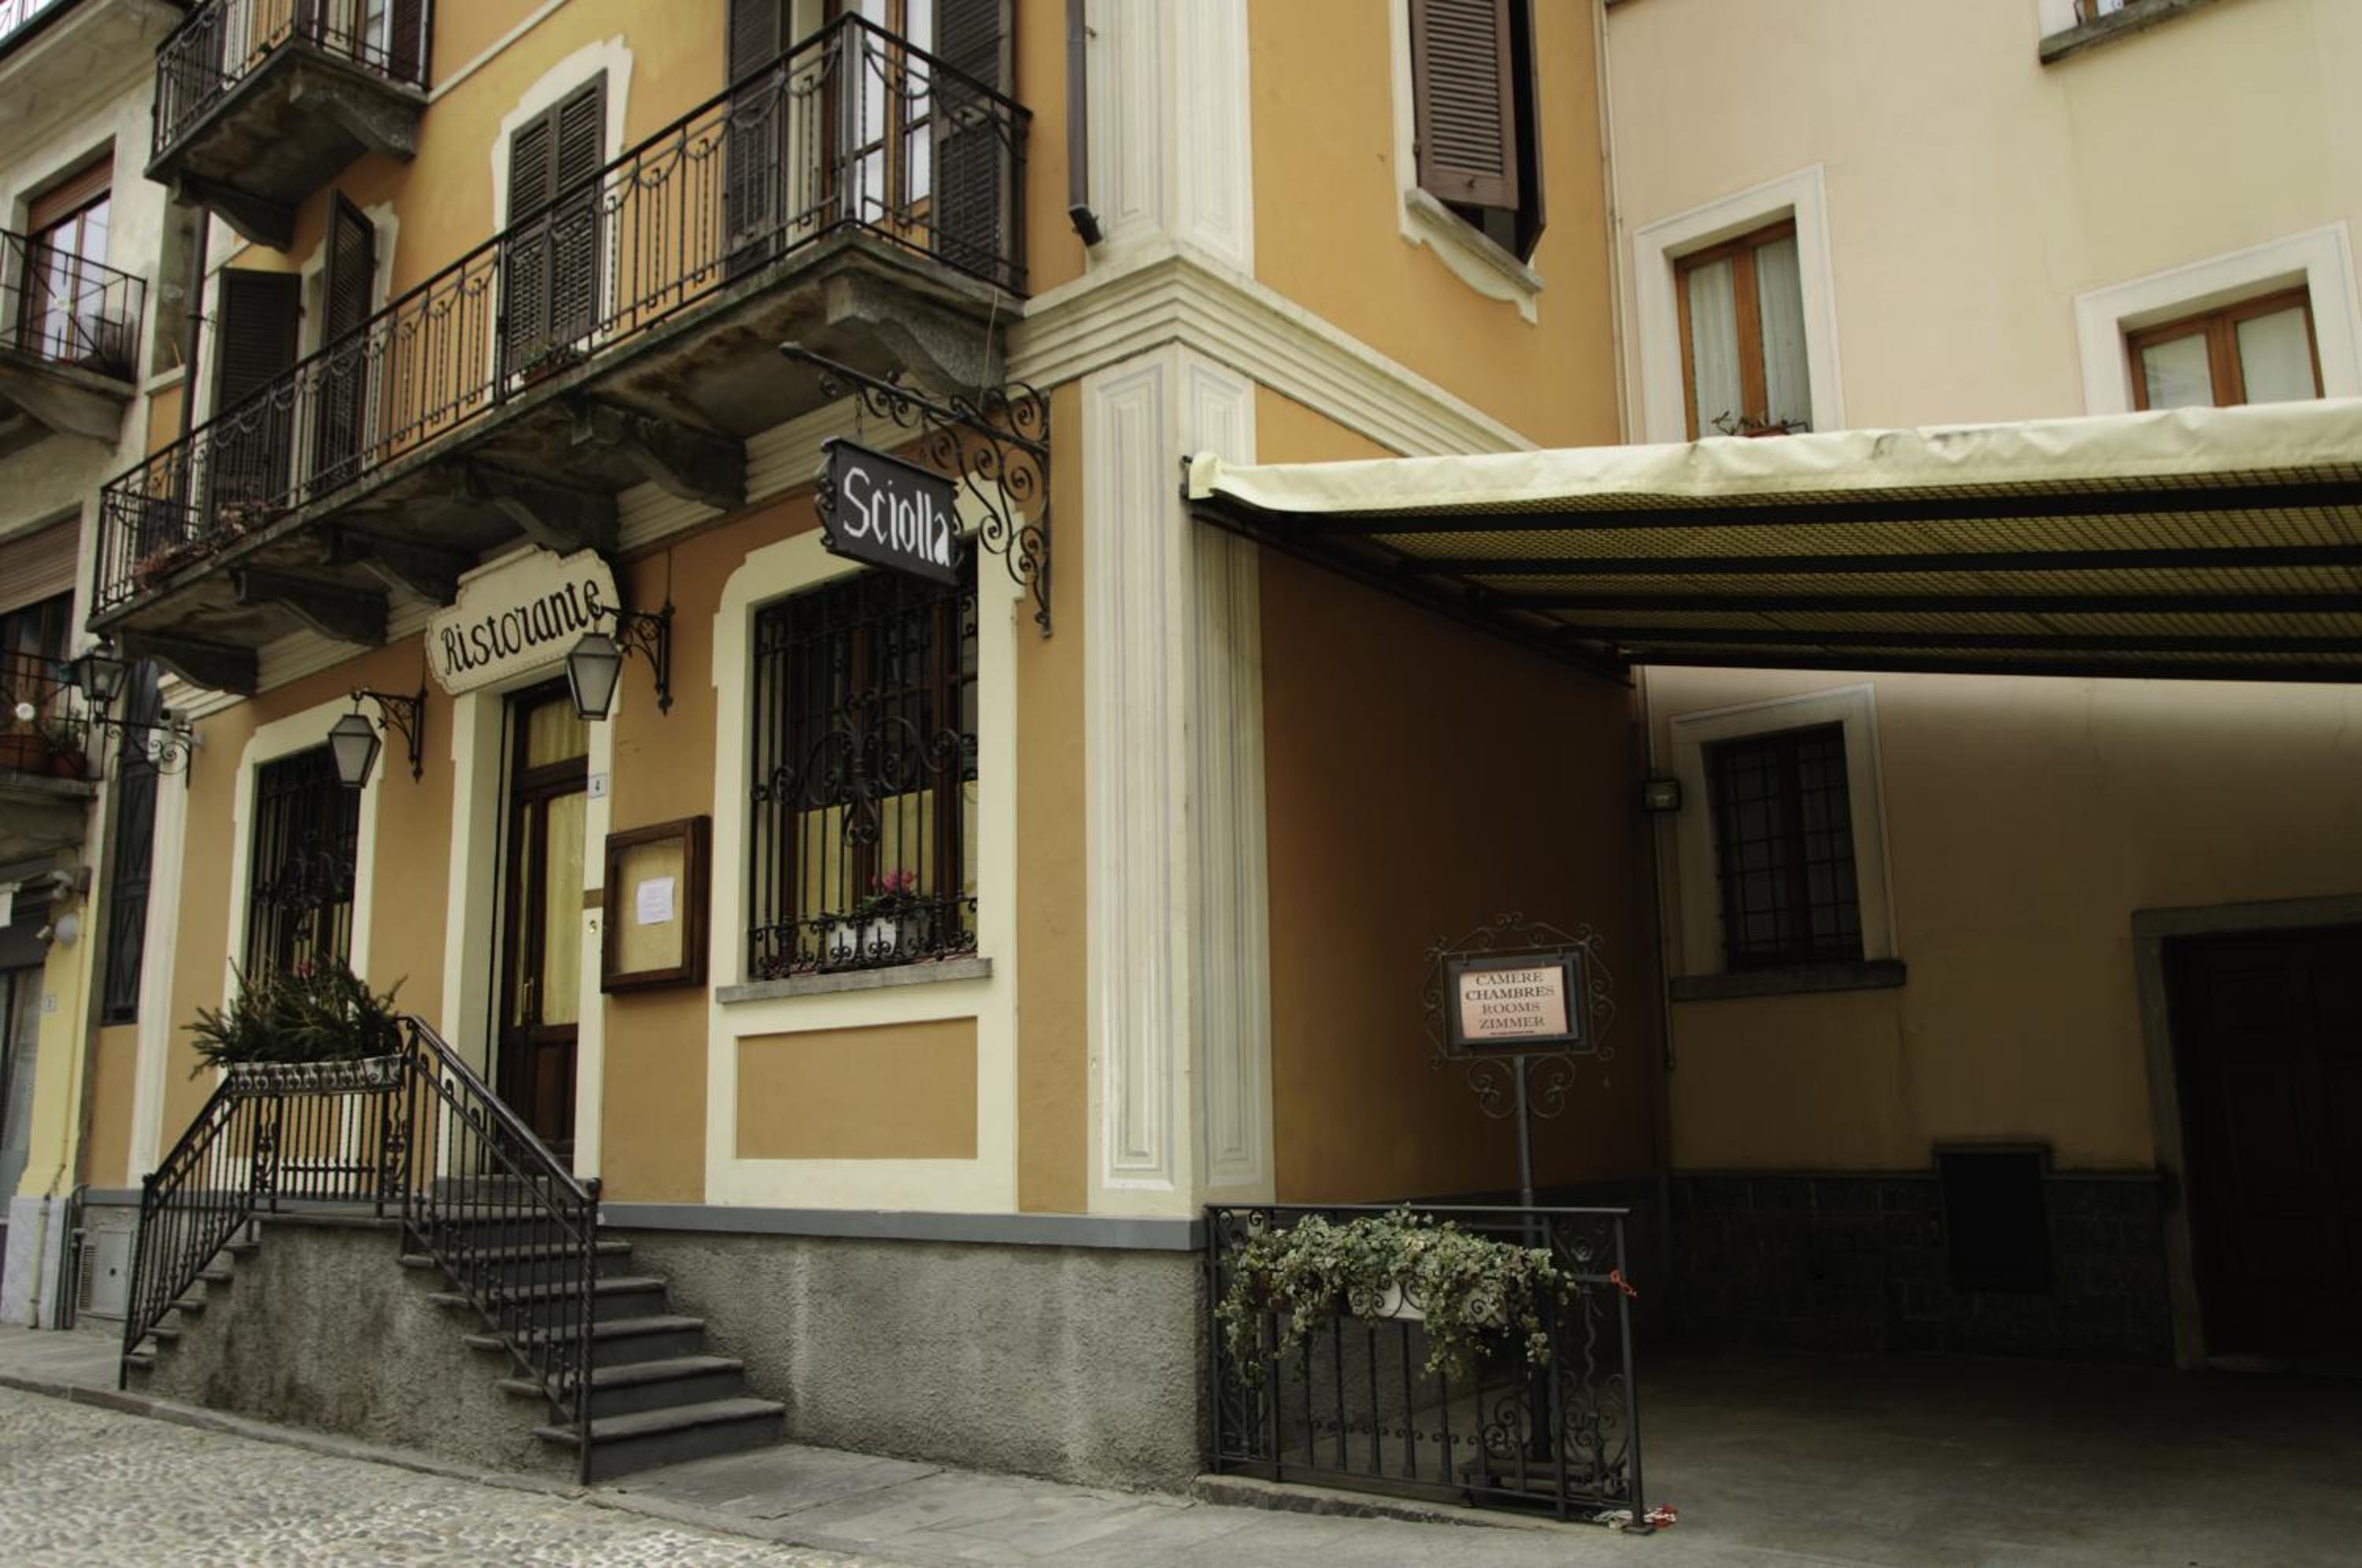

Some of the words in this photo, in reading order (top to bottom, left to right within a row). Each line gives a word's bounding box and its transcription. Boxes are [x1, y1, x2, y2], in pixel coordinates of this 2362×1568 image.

[844, 467, 950, 567] Sciolla
[441, 579, 604, 675] Ristorante
[1475, 971, 1543, 986] CAMERE
[1465, 986, 1554, 1000] CHAMBRES
[1483, 1001, 1540, 1015] ROOMS
[1479, 1016, 1545, 1030] ZIMMER
